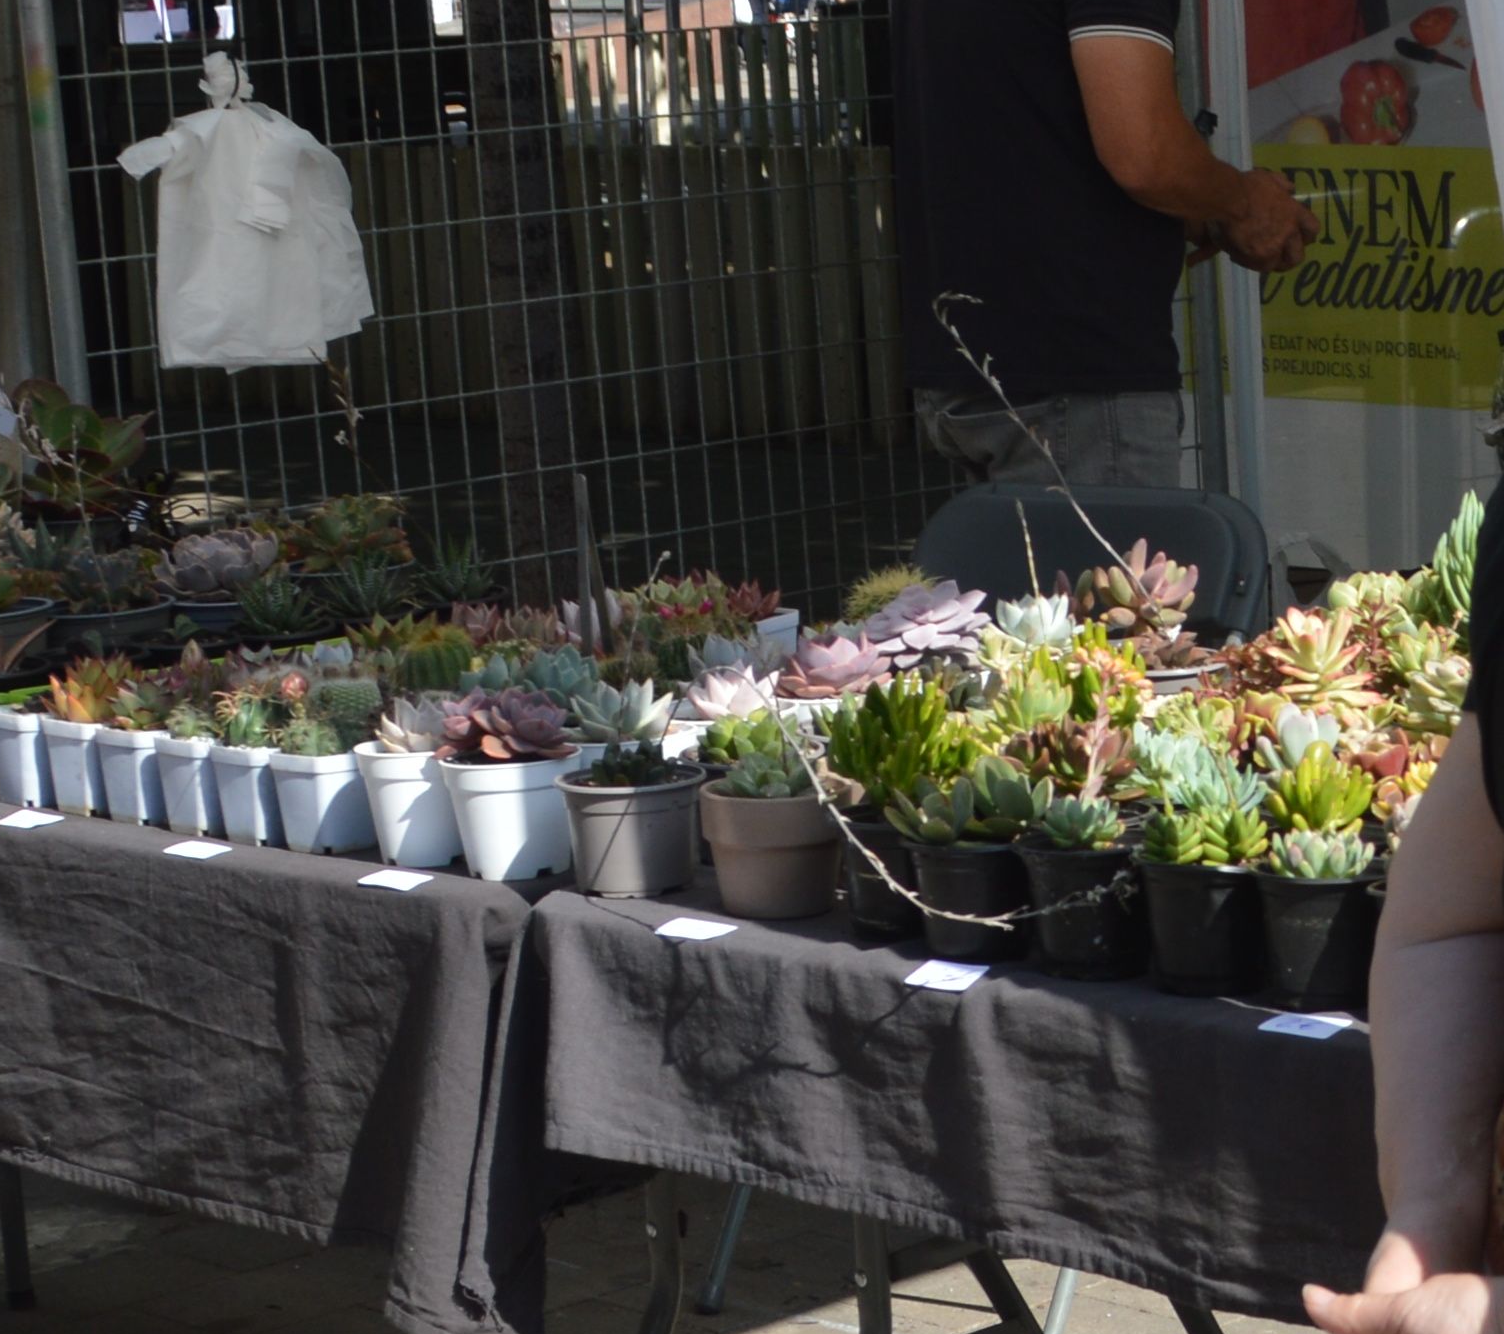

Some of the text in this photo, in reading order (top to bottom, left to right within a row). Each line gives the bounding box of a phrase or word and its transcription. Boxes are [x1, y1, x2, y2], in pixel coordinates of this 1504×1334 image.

[1270, 334, 1302, 352] EDAT
[1307, 336, 1330, 353] NO
[1333, 332, 1349, 354] ÉS
[1352, 338, 1373, 356] UN
[1273, 359, 1356, 380] PREJUDICIS,
